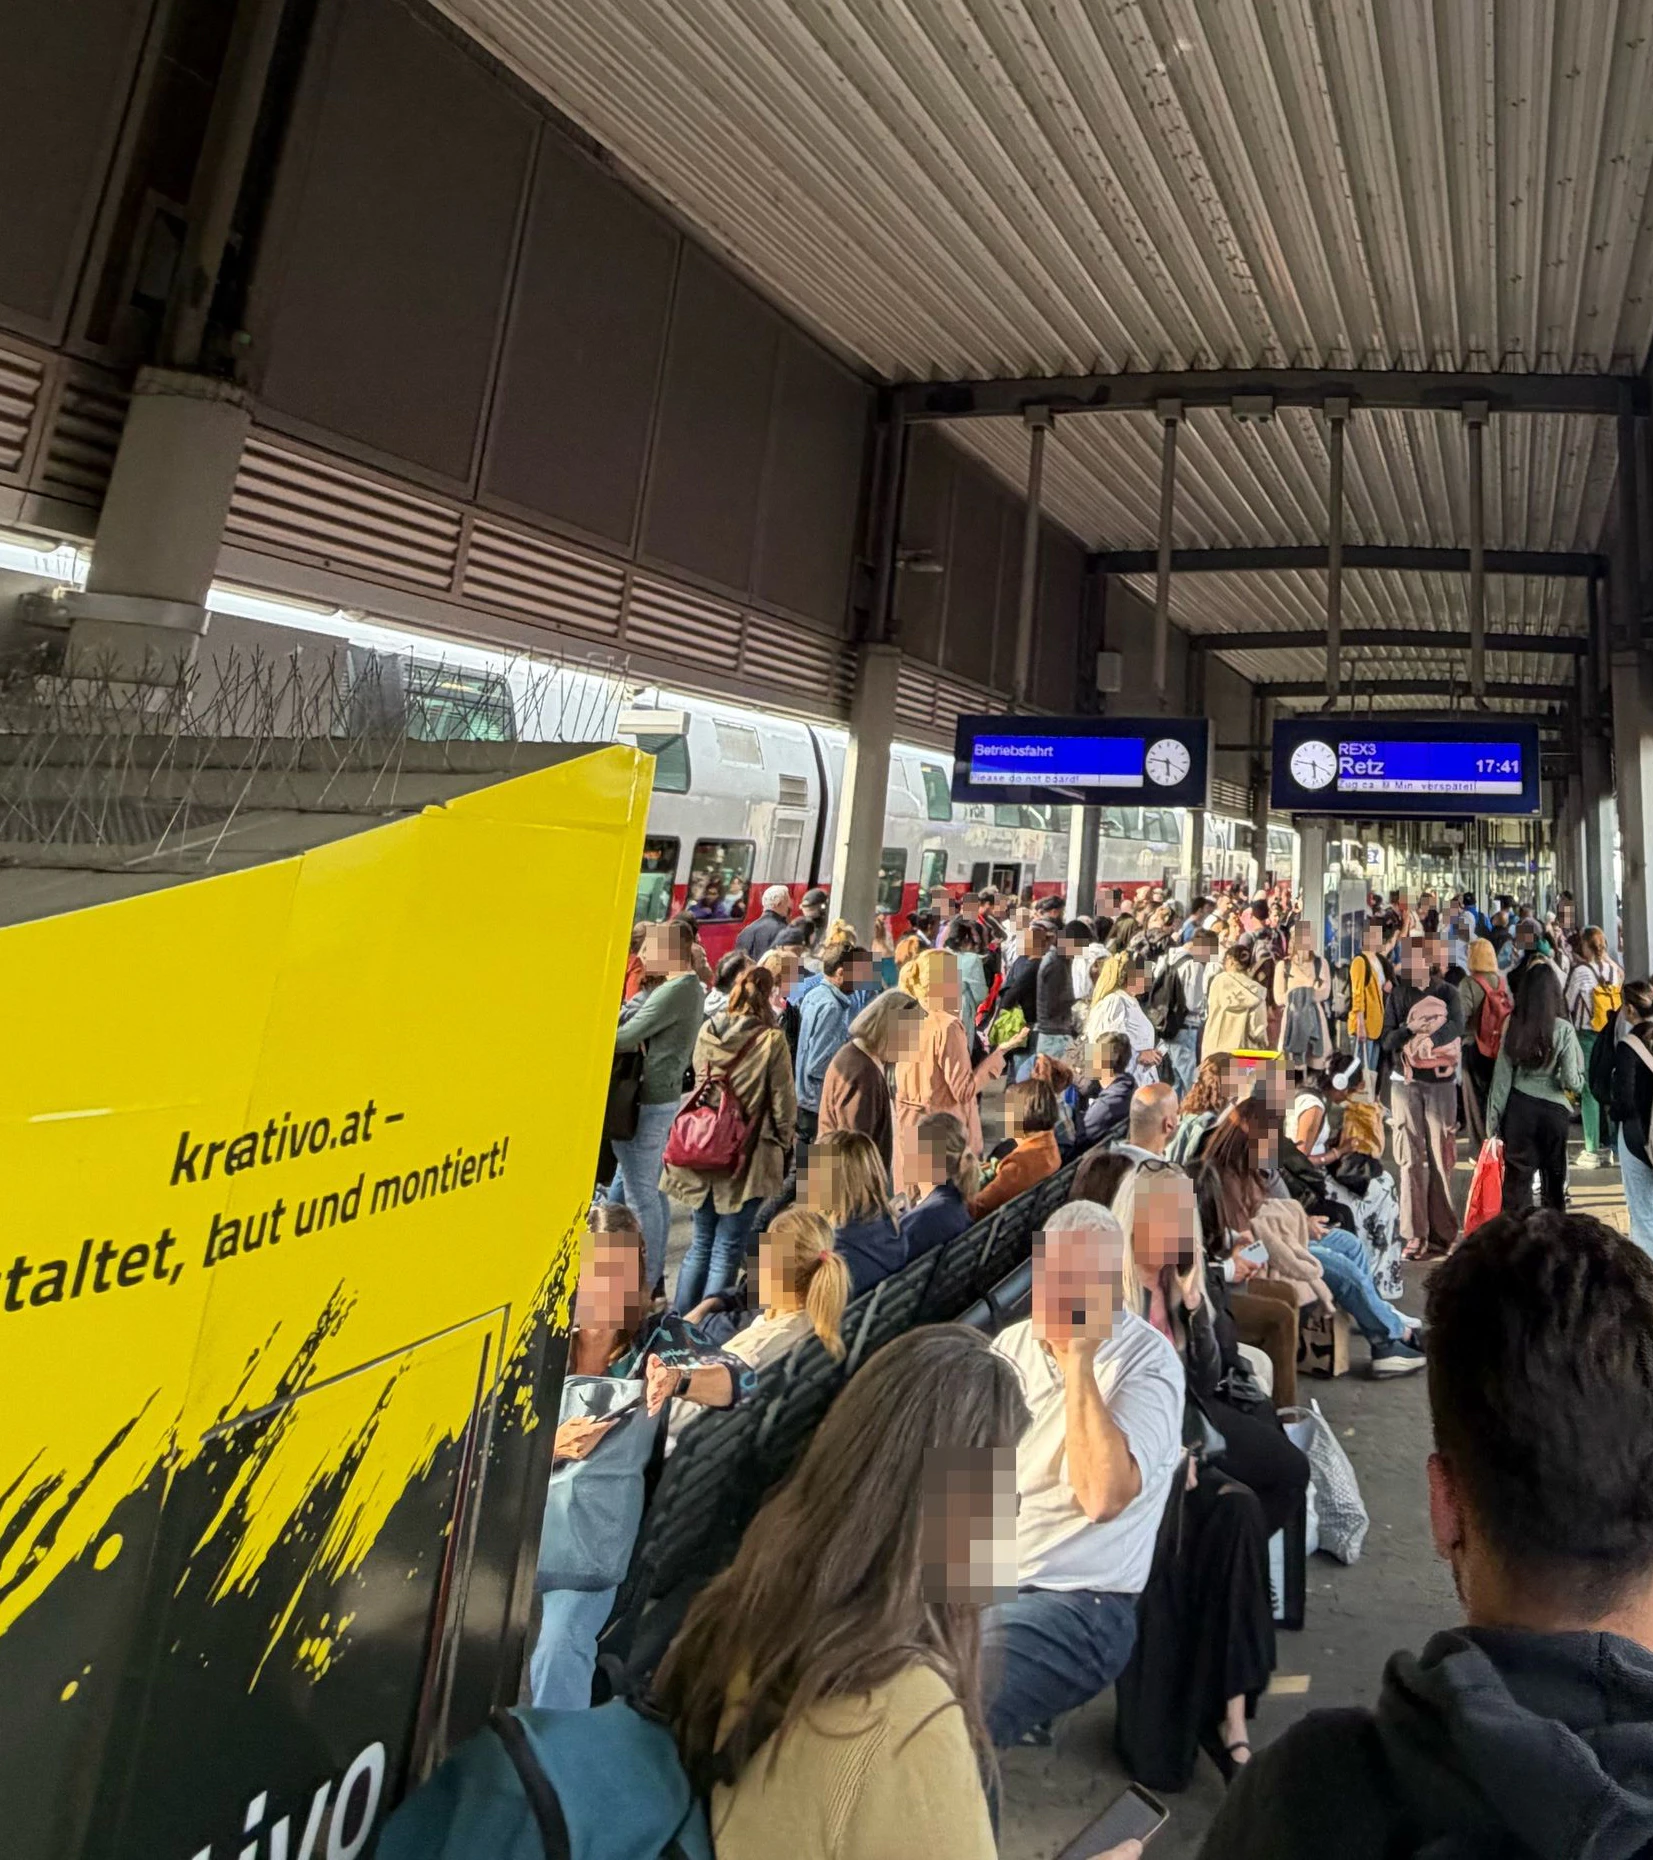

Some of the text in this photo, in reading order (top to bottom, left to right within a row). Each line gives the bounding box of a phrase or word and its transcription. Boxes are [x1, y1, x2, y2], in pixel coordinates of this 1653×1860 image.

[973, 743, 1054, 758] Betriebsfahrt
[1338, 743, 1377, 756] REX3
[1338, 758, 1385, 776] Retz
[1475, 759, 1520, 774] 17:41
[170, 1099, 377, 1187] krativo.at
[0, 1136, 510, 1313] taltet, laut und montiert!
